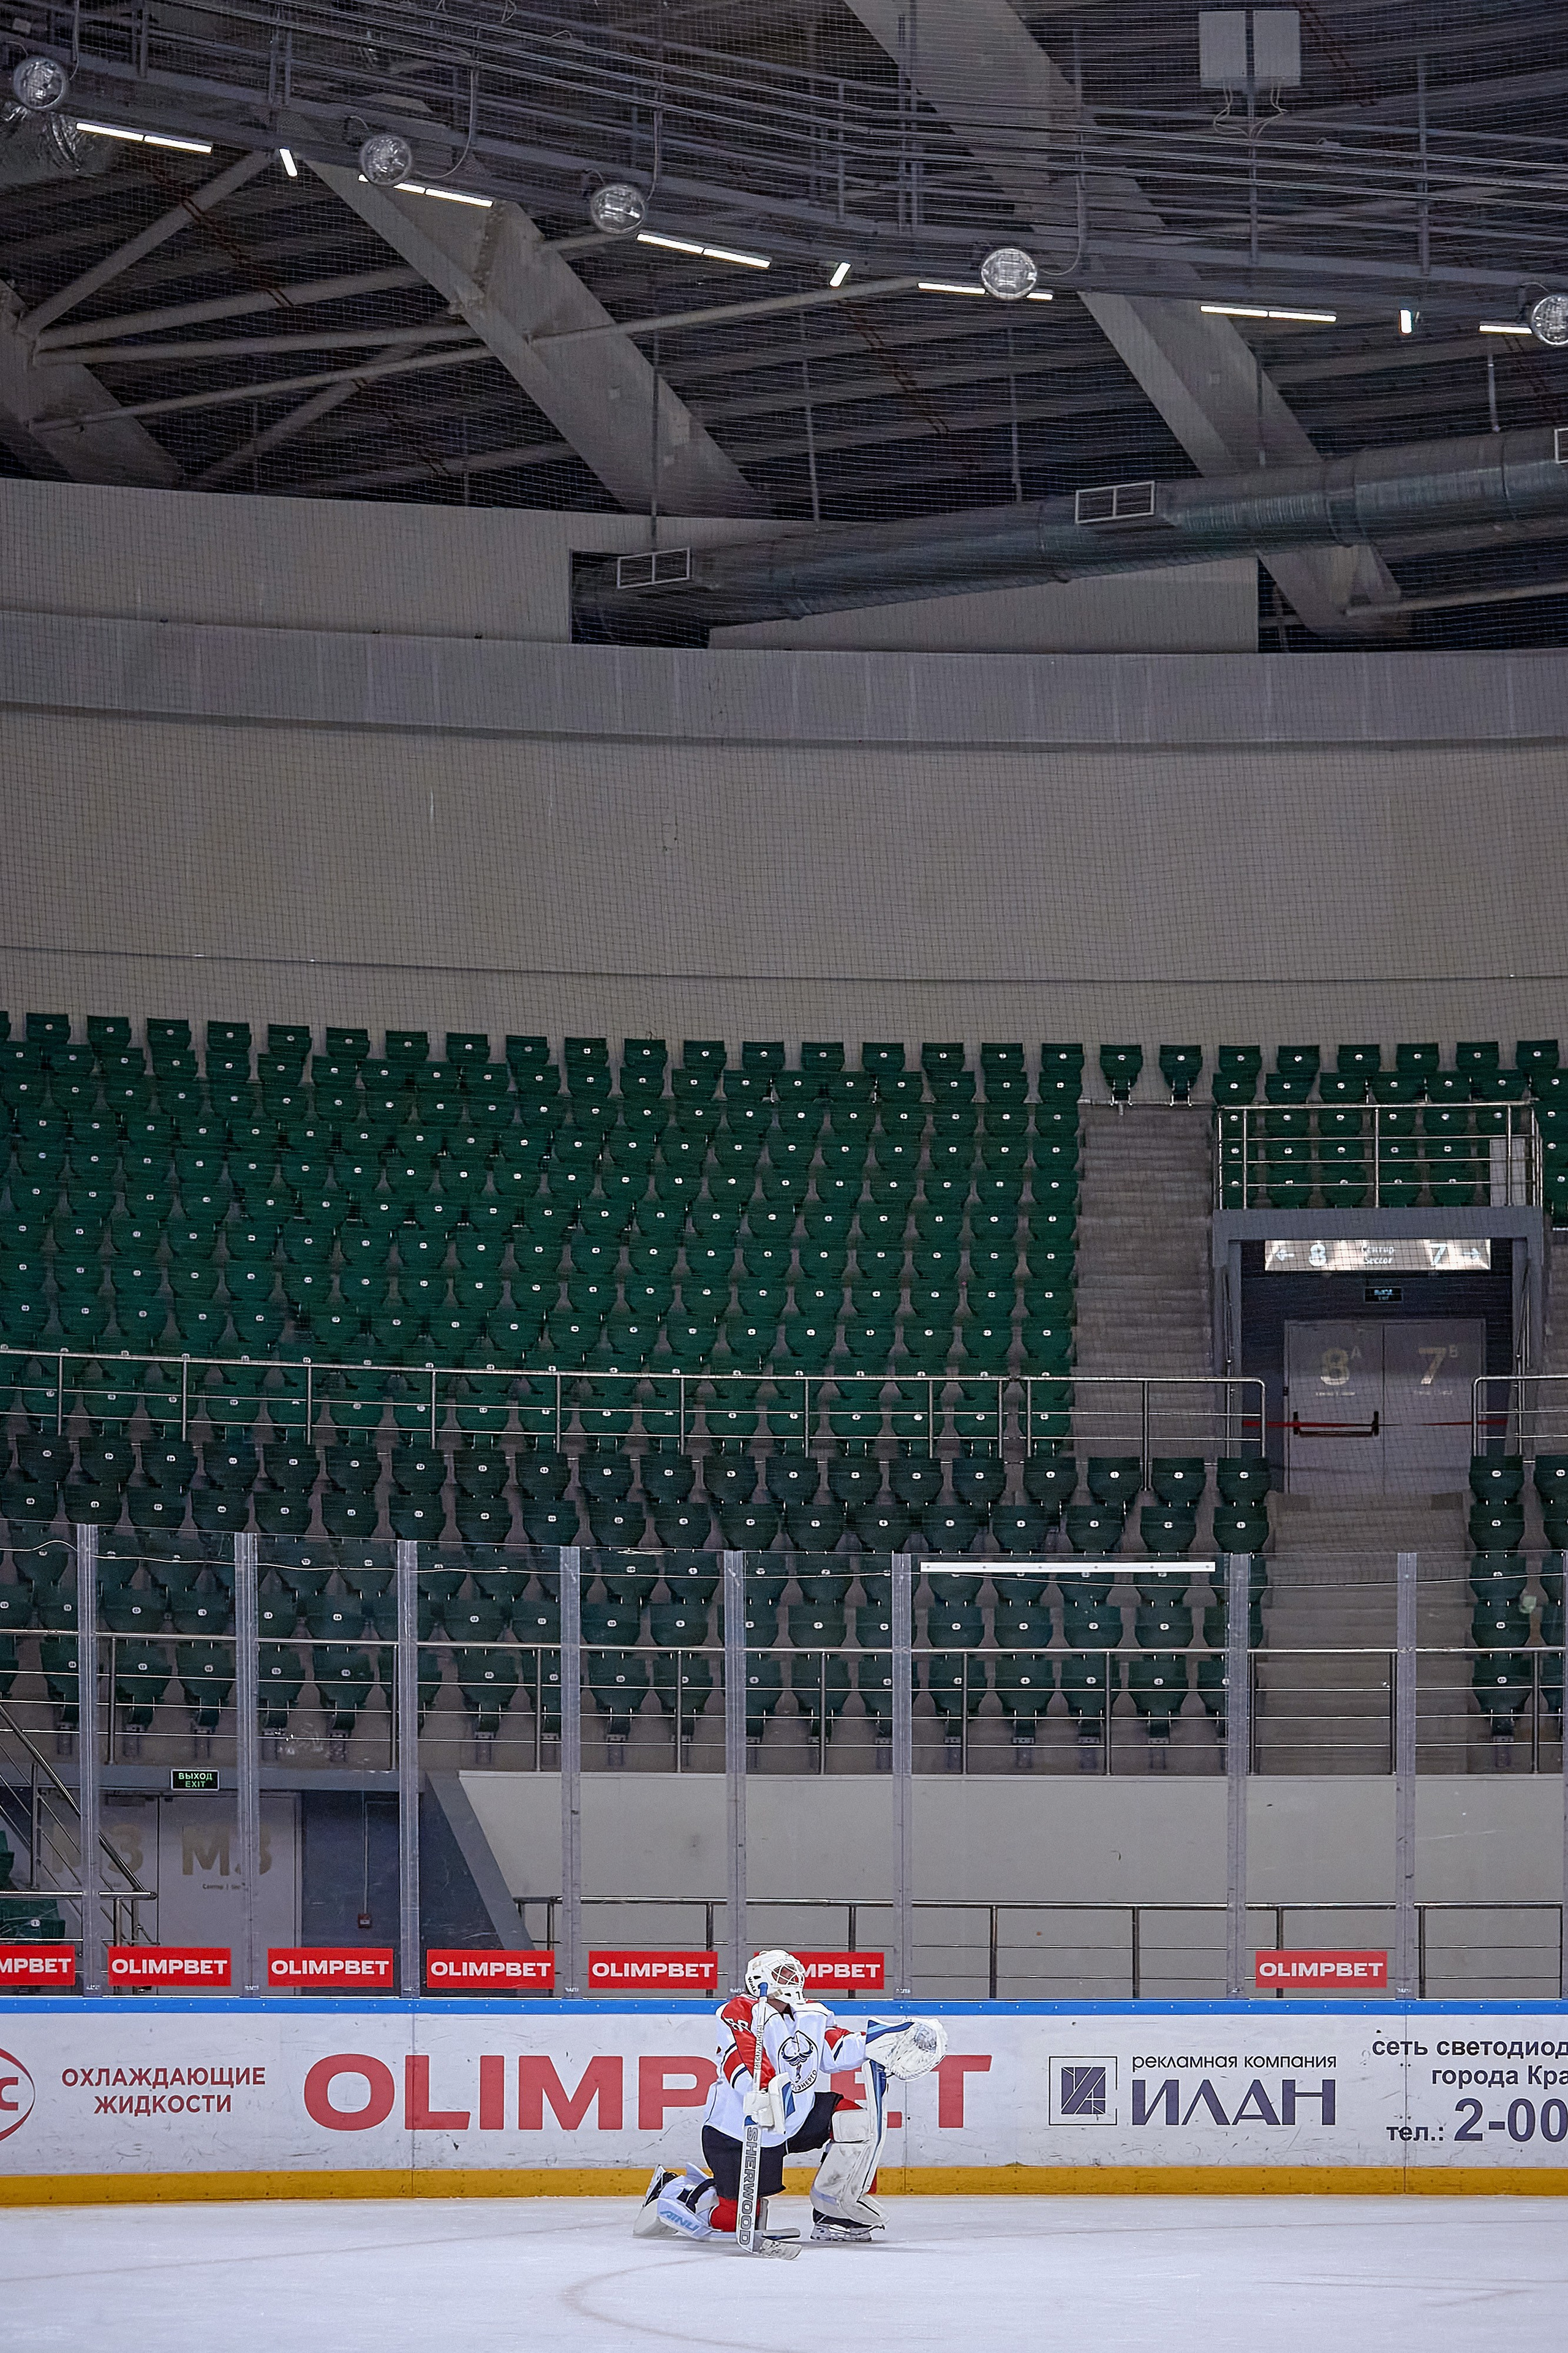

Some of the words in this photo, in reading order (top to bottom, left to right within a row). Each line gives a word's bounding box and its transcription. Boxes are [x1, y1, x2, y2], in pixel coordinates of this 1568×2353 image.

[1309, 1243, 1327, 1267] 8
[1430, 1243, 1447, 1266] 7
[178, 1772, 213, 1781] ВЫХОД
[111, 1959, 228, 1975] OLIMPBET
[271, 1960, 390, 1975] OLIMPBET
[431, 1961, 551, 1976] OLIMPBET
[592, 1962, 714, 1978] OLIMPBET
[1259, 1962, 1384, 1977] OLIMPBET
[1372, 2041, 1428, 2056] сеть
[1132, 2055, 1238, 2073] рекламная
[1244, 2055, 1337, 2068] компания
[62, 2068, 266, 2088] ОХЛАЖДАЮЩИЕ
[1431, 2069, 1519, 2090] города
[94, 2095, 231, 2117] ЖИДКОСТИ
[1131, 2079, 1336, 2126] ИЛАН
[1385, 2126, 1444, 2142] тел.:
[1453, 2098, 1568, 2143] 2-00
[739, 2126, 759, 2246] SHERWOOD
